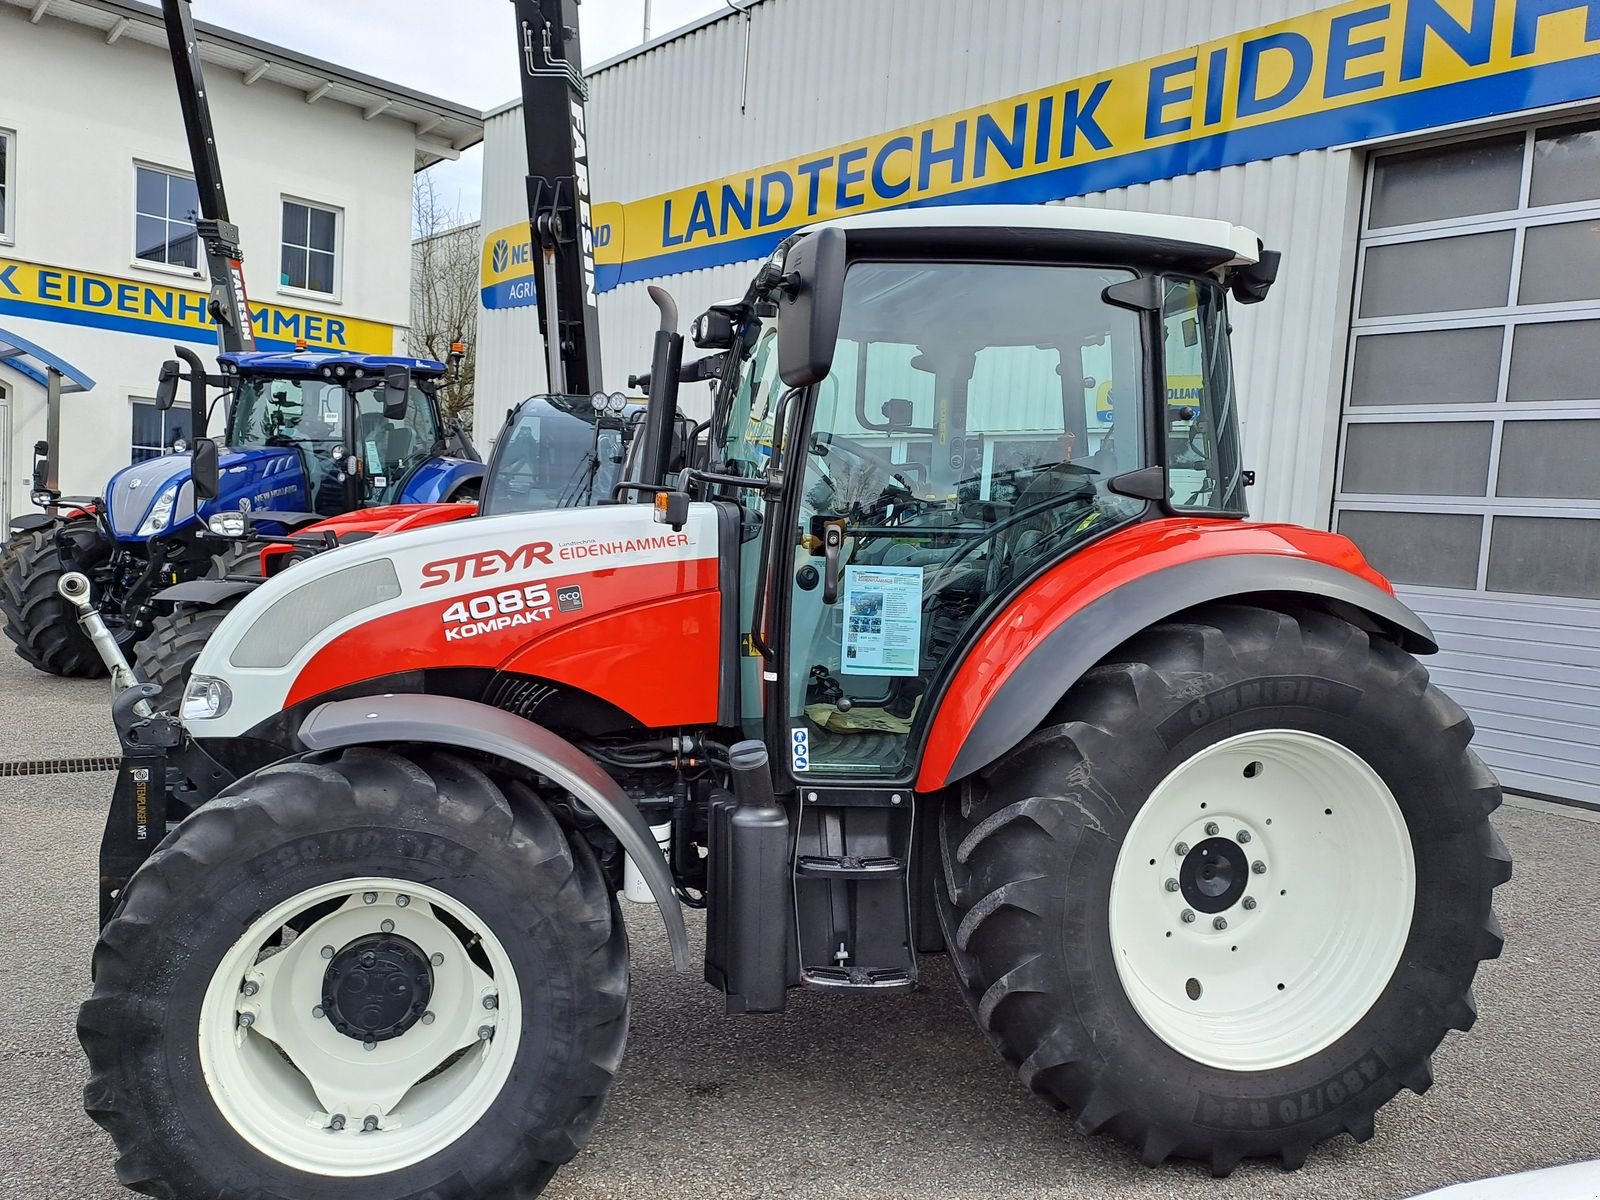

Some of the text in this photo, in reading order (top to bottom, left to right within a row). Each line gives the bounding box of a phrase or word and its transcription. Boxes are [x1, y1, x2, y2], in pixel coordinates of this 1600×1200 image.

[661, 79, 1113, 248] LANDTECHNIK
[570, 99, 597, 309] FARESIN
[511, 242, 533, 266] NE
[38, 269, 347, 346] EIDENHMMER
[231, 268, 252, 341] FARESIN
[508, 281, 536, 300] AGRI
[254, 491, 270, 504] NEW
[419, 541, 554, 590] STEYR
[559, 533, 689, 561] EIDENHAMMER
[442, 583, 551, 625] 4085
[558, 590, 580, 602] eco
[444, 607, 553, 642] KOMPAKT
[136, 782, 147, 825] STEMPLINGER
